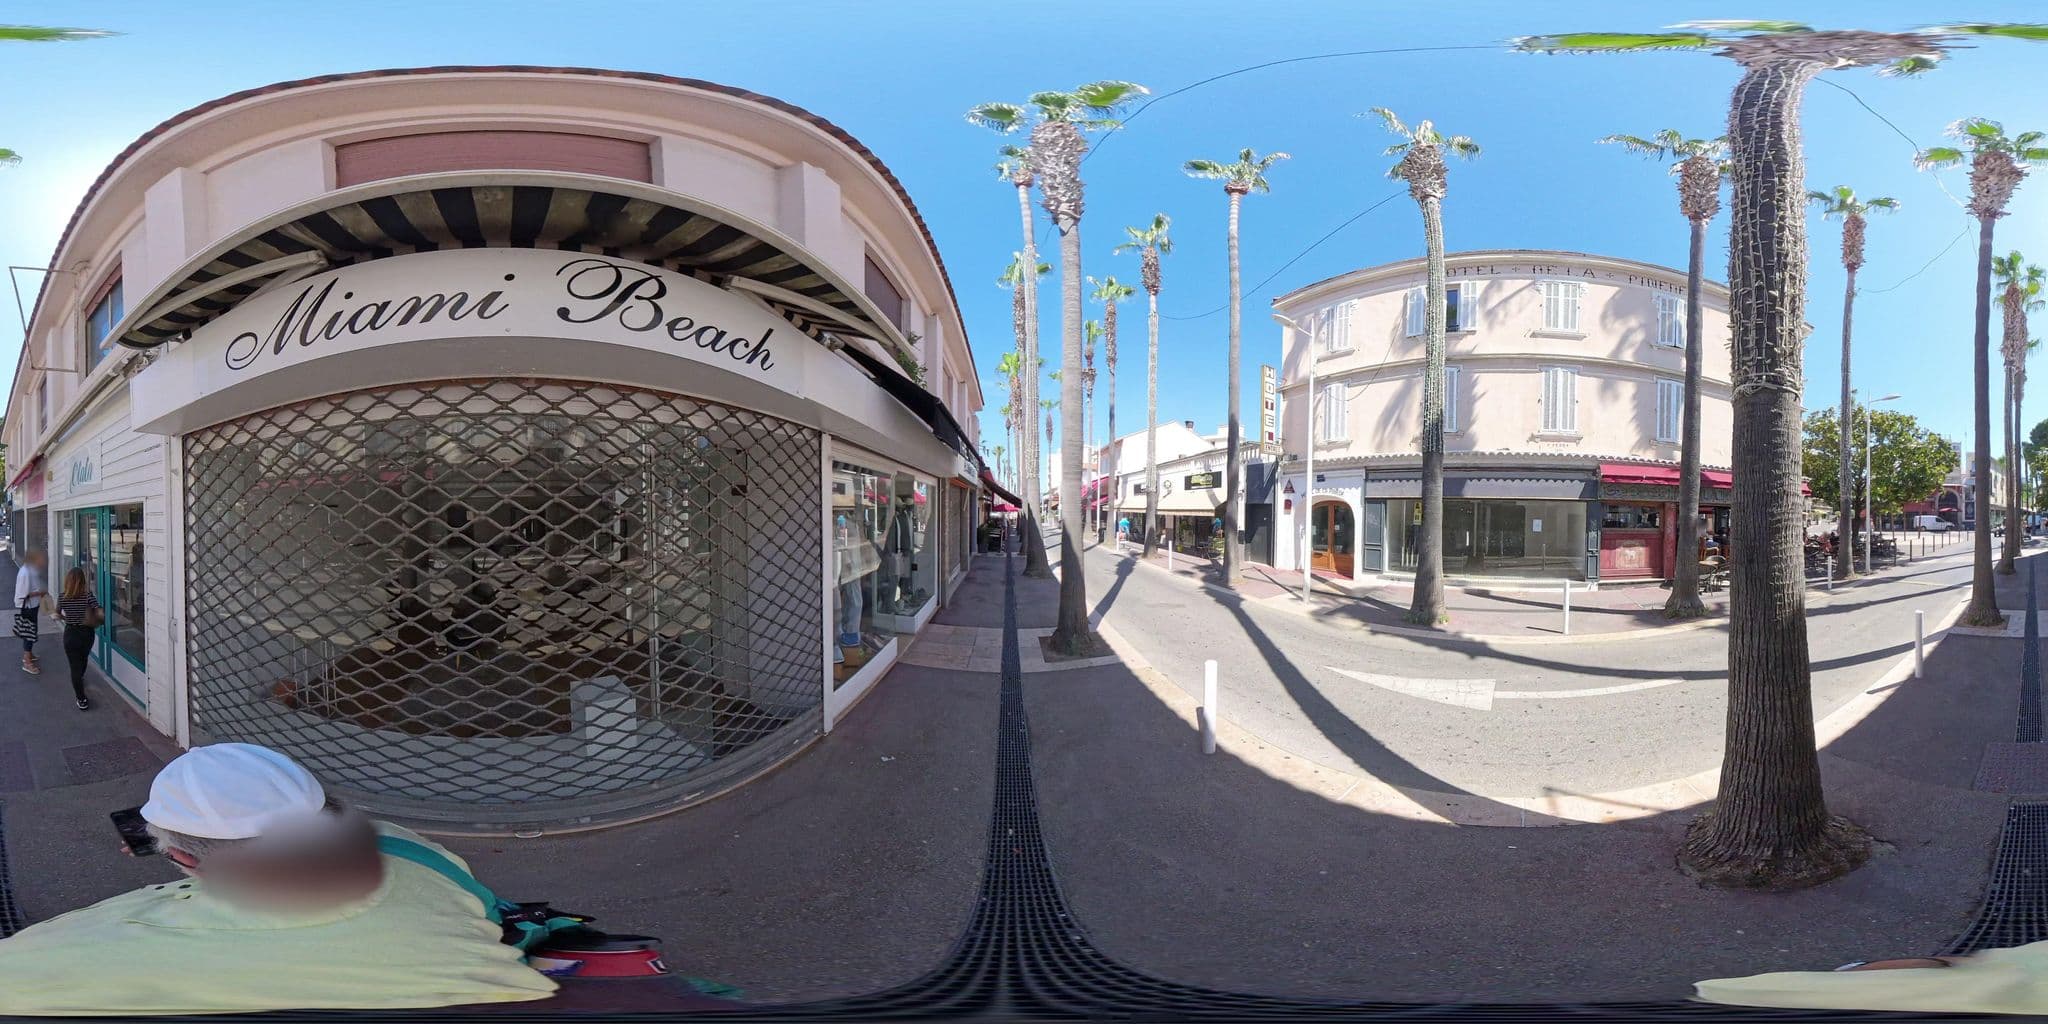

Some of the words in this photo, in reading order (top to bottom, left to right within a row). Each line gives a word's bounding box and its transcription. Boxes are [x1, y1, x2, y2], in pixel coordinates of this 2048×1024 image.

[1446, 265, 1501, 278] OTEL
[225, 272, 517, 371] Miami
[555, 258, 774, 372] Beach
[1264, 365, 1275, 444] HOTEL
